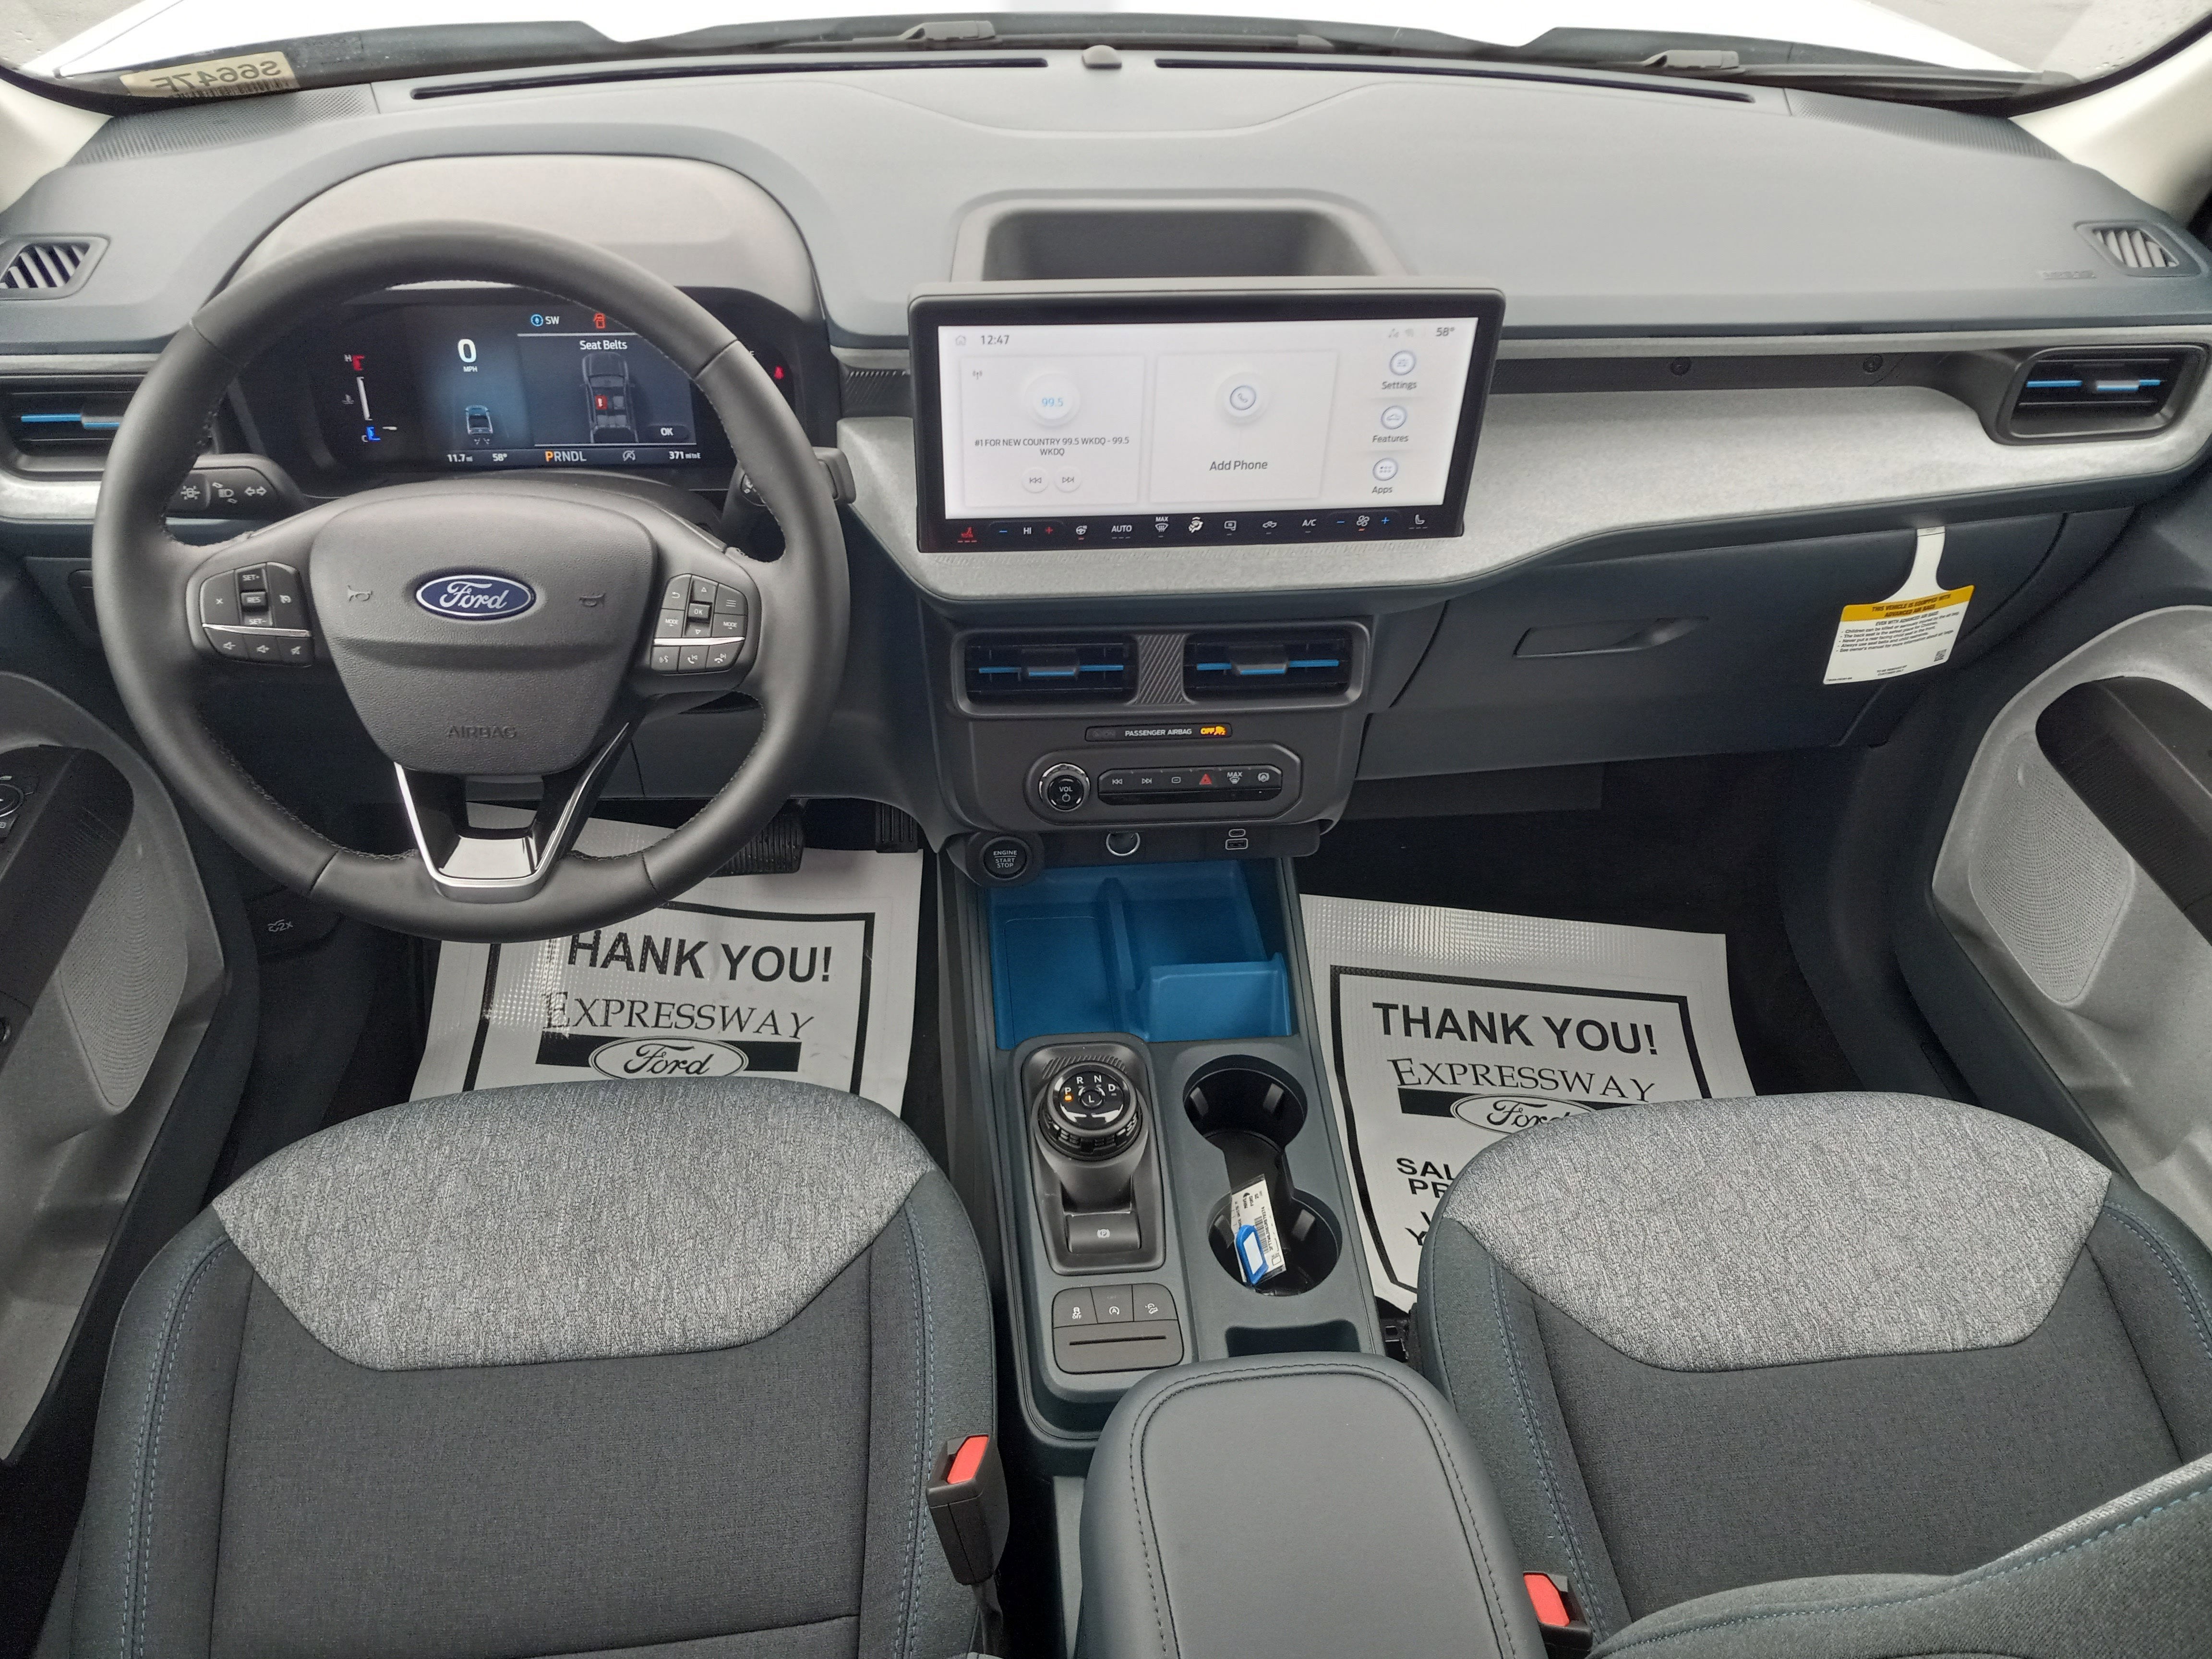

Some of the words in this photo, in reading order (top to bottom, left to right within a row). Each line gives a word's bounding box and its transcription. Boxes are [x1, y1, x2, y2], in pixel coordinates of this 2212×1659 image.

[545, 316, 559, 325] SW
[981, 335, 1010, 345] 12:47
[579, 340, 601, 350] Seat
[603, 340, 627, 349] Belts
[457, 339, 477, 363] 0
[1382, 381, 1418, 390] Settings
[1041, 397, 1063, 407] 99.5
[661, 428, 673, 436] OK
[1023, 438, 1060, 446] COUNTRY
[1081, 437, 1106, 446] WKDQ
[492, 453, 507, 461] 58°
[669, 451, 684, 459] 371
[1040, 448, 1065, 457] WKDQ
[447, 454, 465, 462] 11.7
[1209, 460, 1231, 471] Add
[1233, 460, 1268, 470] Phone
[1371, 486, 1393, 494] Apps
[1302, 519, 1317, 527] A/C
[1111, 525, 1132, 533] AUTO
[440, 581, 509, 609] Ford
[1914, 597, 1937, 606] EQUIPPED
[1884, 609, 1912, 617] ADVANCED
[448, 725, 517, 739] AIRBAG
[543, 930, 708, 979] HANK
[721, 943, 832, 983] YOU!
[1372, 1002, 1534, 1047] THANK
[1542, 1016, 1658, 1055] YOU!
[624, 1043, 714, 1075] Ford
[1077, 1076, 1084, 1084] R
[1094, 1075, 1102, 1083] N
[1388, 1058, 1655, 1103] EXPRESSWAY
[1065, 1087, 1071, 1095] P
[1088, 1095, 1095, 1103] L
